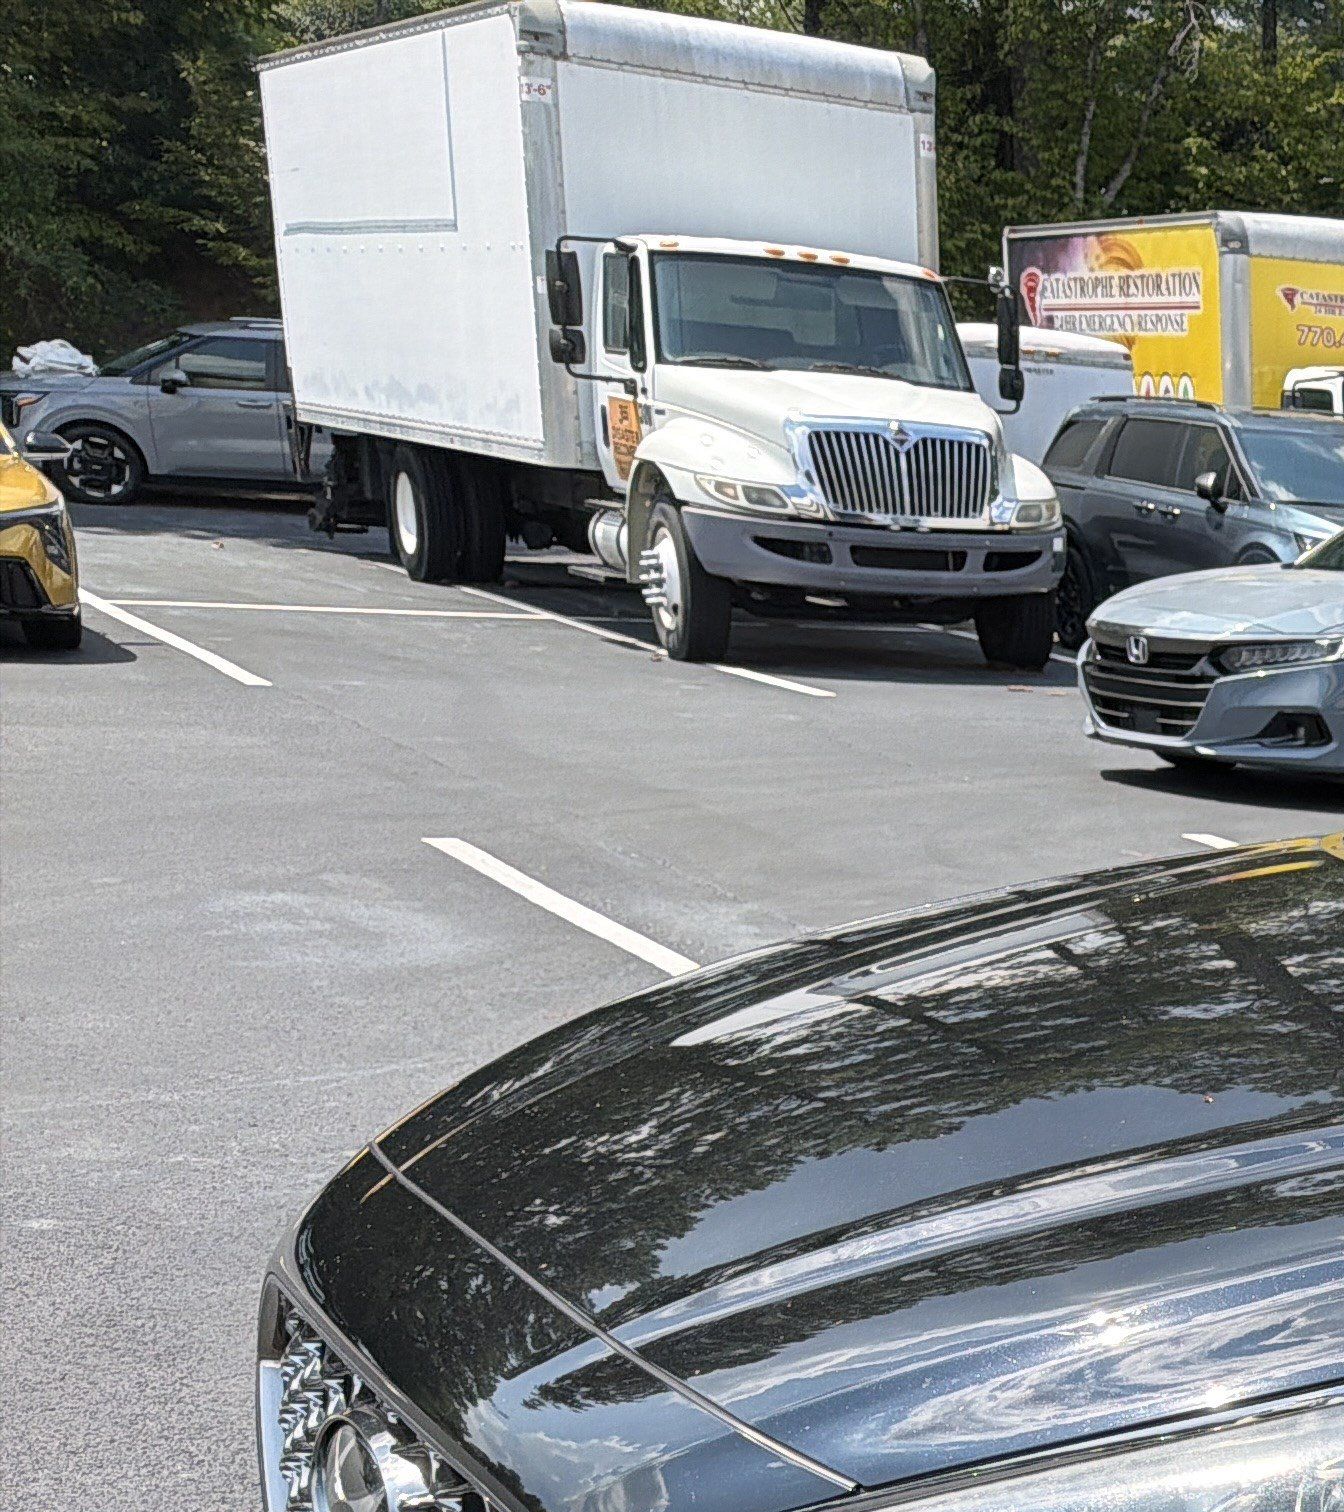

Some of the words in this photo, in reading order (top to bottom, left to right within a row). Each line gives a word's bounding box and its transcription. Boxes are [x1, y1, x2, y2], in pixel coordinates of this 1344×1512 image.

[1042, 275, 1115, 299] CATASTROPHE
[1118, 271, 1200, 299] RESTORATION
[1078, 313, 1135, 332] EMERGENCY
[1137, 312, 1187, 332] RESPONSE
